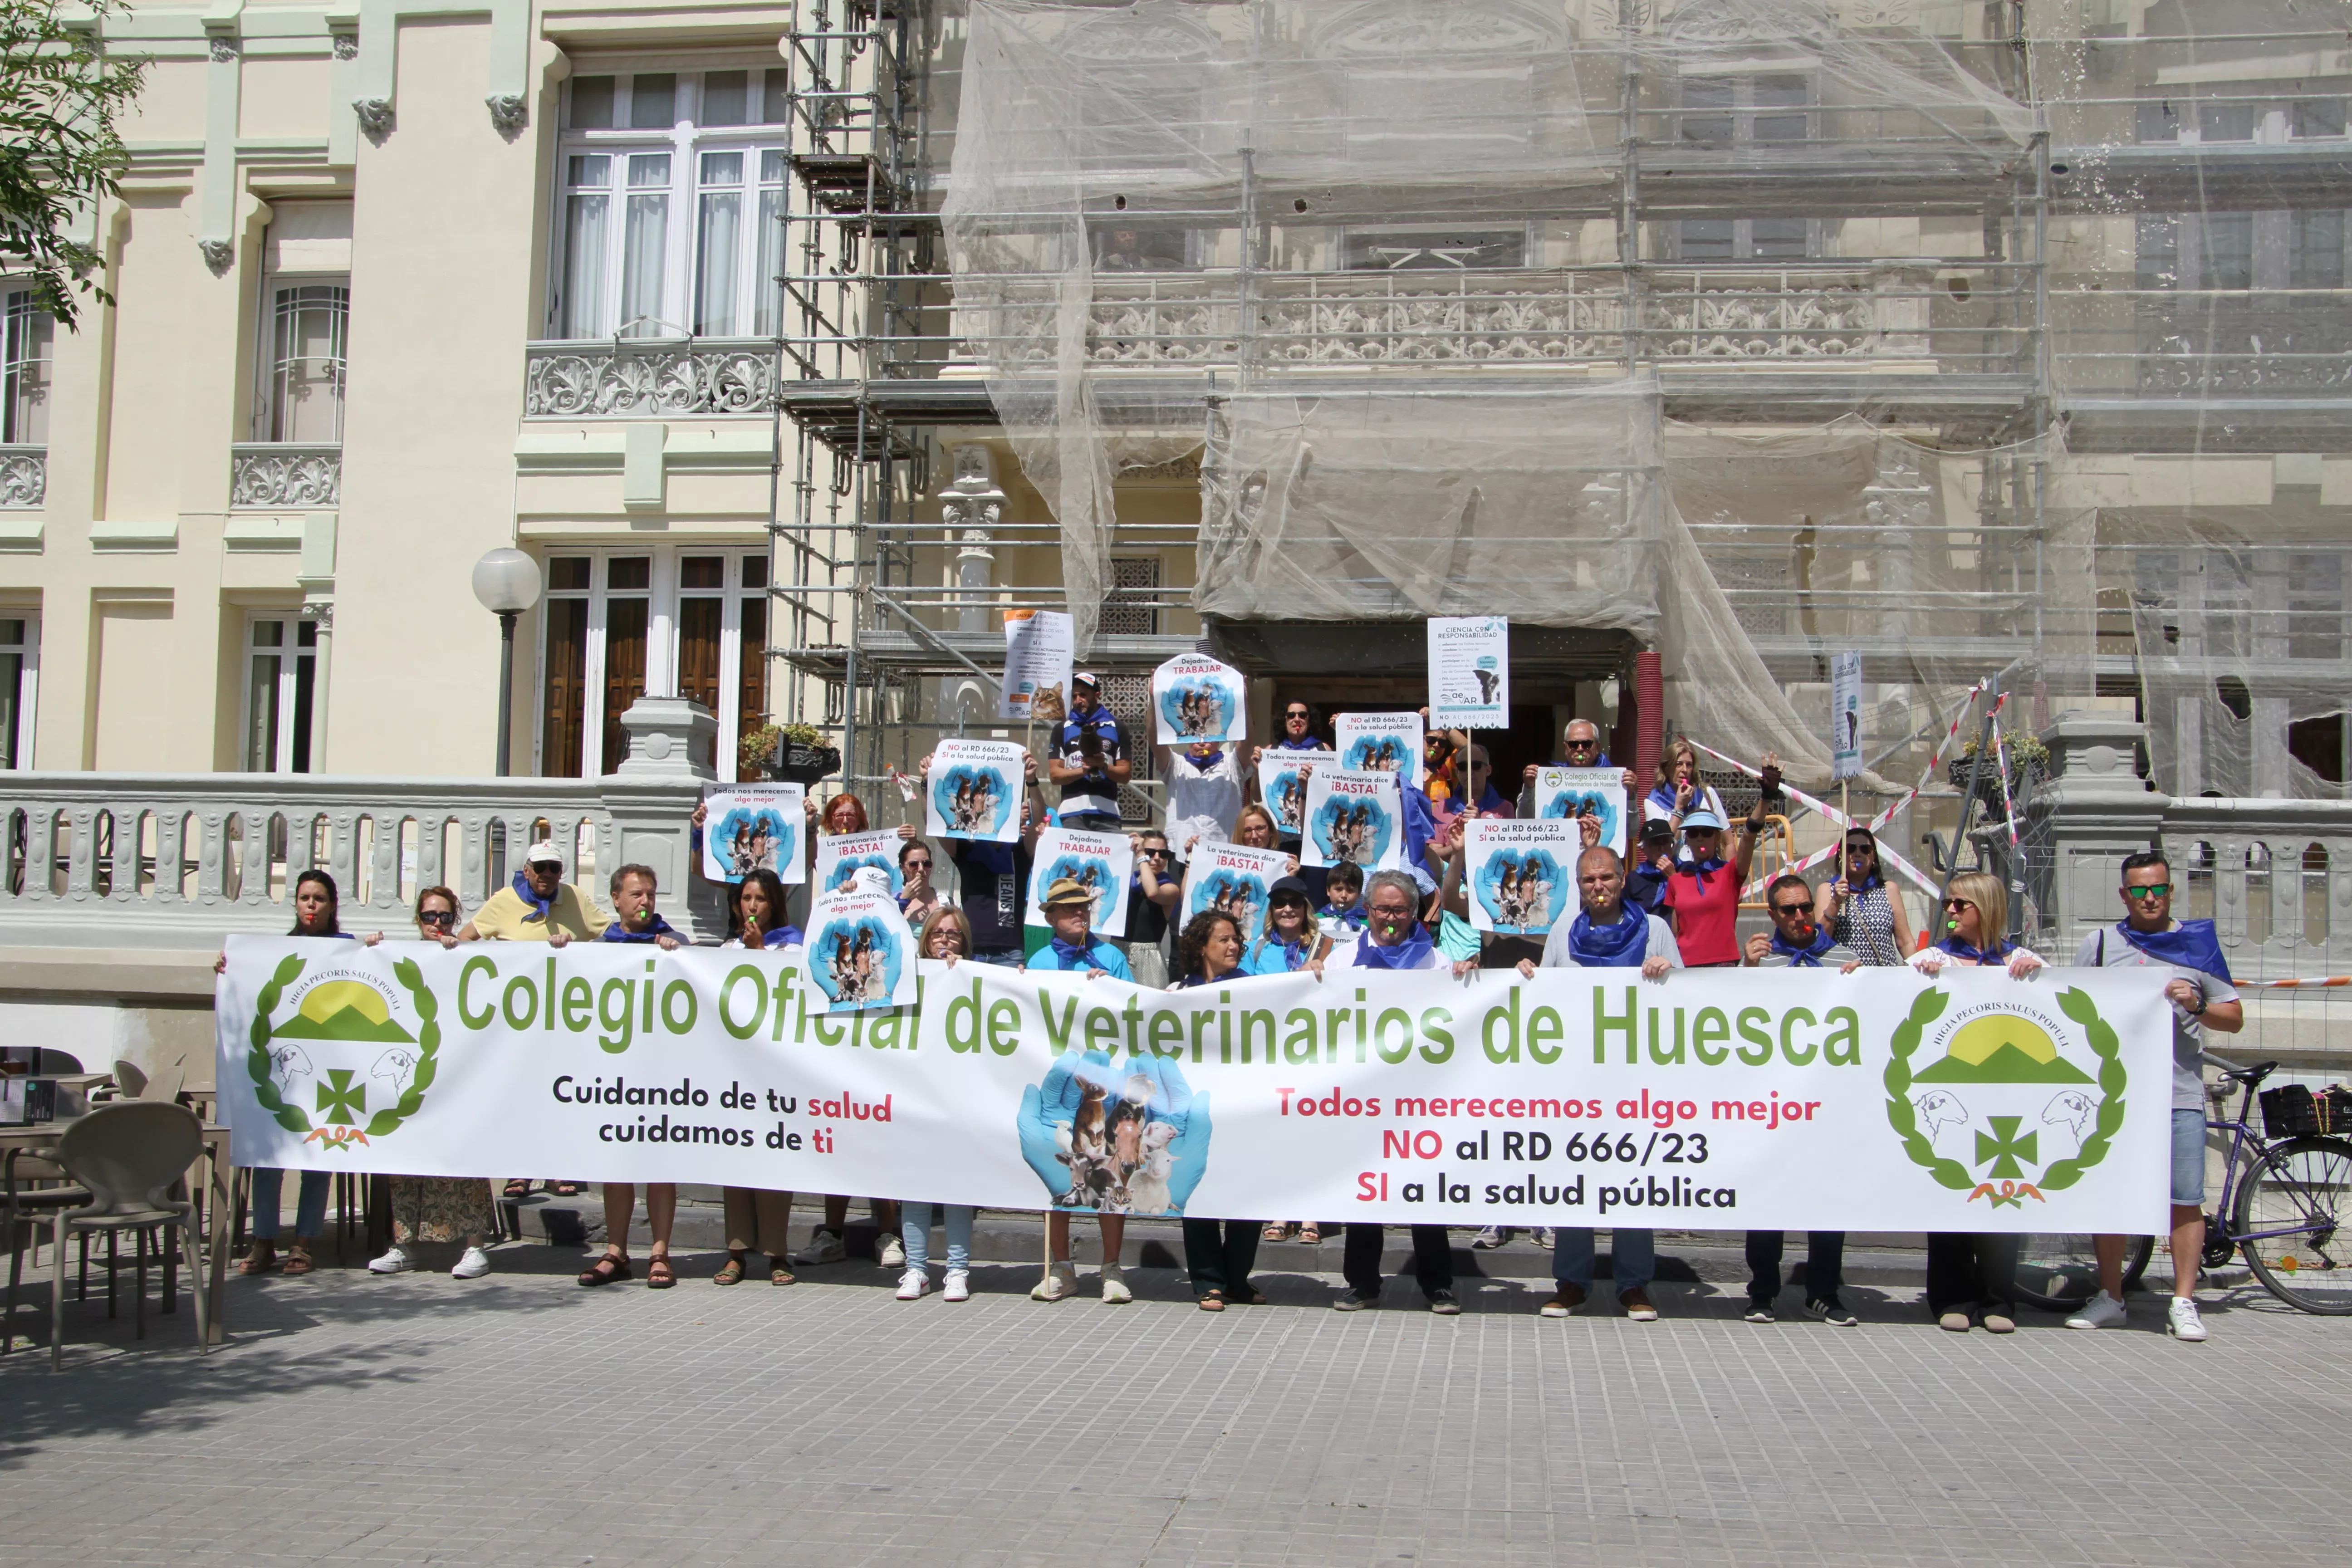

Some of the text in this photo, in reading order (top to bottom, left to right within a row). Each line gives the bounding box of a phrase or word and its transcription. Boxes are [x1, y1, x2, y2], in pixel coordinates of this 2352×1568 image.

[1173, 665, 1221, 674] TRABAJAR
[1332, 774, 1372, 783] veterinaria
[1564, 773, 1588, 781] Colegio
[1332, 781, 1377, 794] ¡BASTA!
[1527, 824, 1559, 833] 666/23
[838, 837, 877, 845] veterinaria
[1069, 834, 1102, 843] Dejadnos
[1534, 834, 1565, 843] pública
[838, 842, 884, 856] ¡BASTA!
[1059, 842, 1111, 855] TRABAJAR
[1219, 848, 1259, 859] veterinaria
[1216, 855, 1264, 872] ¡BASTA!
[1000, 877, 1014, 910] JEANS
[831, 902, 875, 913] algo mejor
[290, 969, 401, 1010] HIGIA PECORIS SALUS POPULI
[458, 955, 698, 1054] Colegio
[945, 977, 1021, 1056] de
[1038, 984, 1455, 1065] Veterinarios
[1482, 986, 1563, 1064] de
[1592, 985, 1862, 1066] Huesca
[1934, 1002, 2069, 1047] HIGIA PECORIS SALUS POPULI
[553, 1075, 892, 1122] Cuidando de tu salud
[1275, 1086, 1822, 1130] Todos merecemos algo mejor
[599, 1114, 833, 1154] cuidamos de ti
[1383, 1130, 1709, 1166] NO al RD 666/23
[1356, 1171, 1736, 1215] SI a la salud pública
